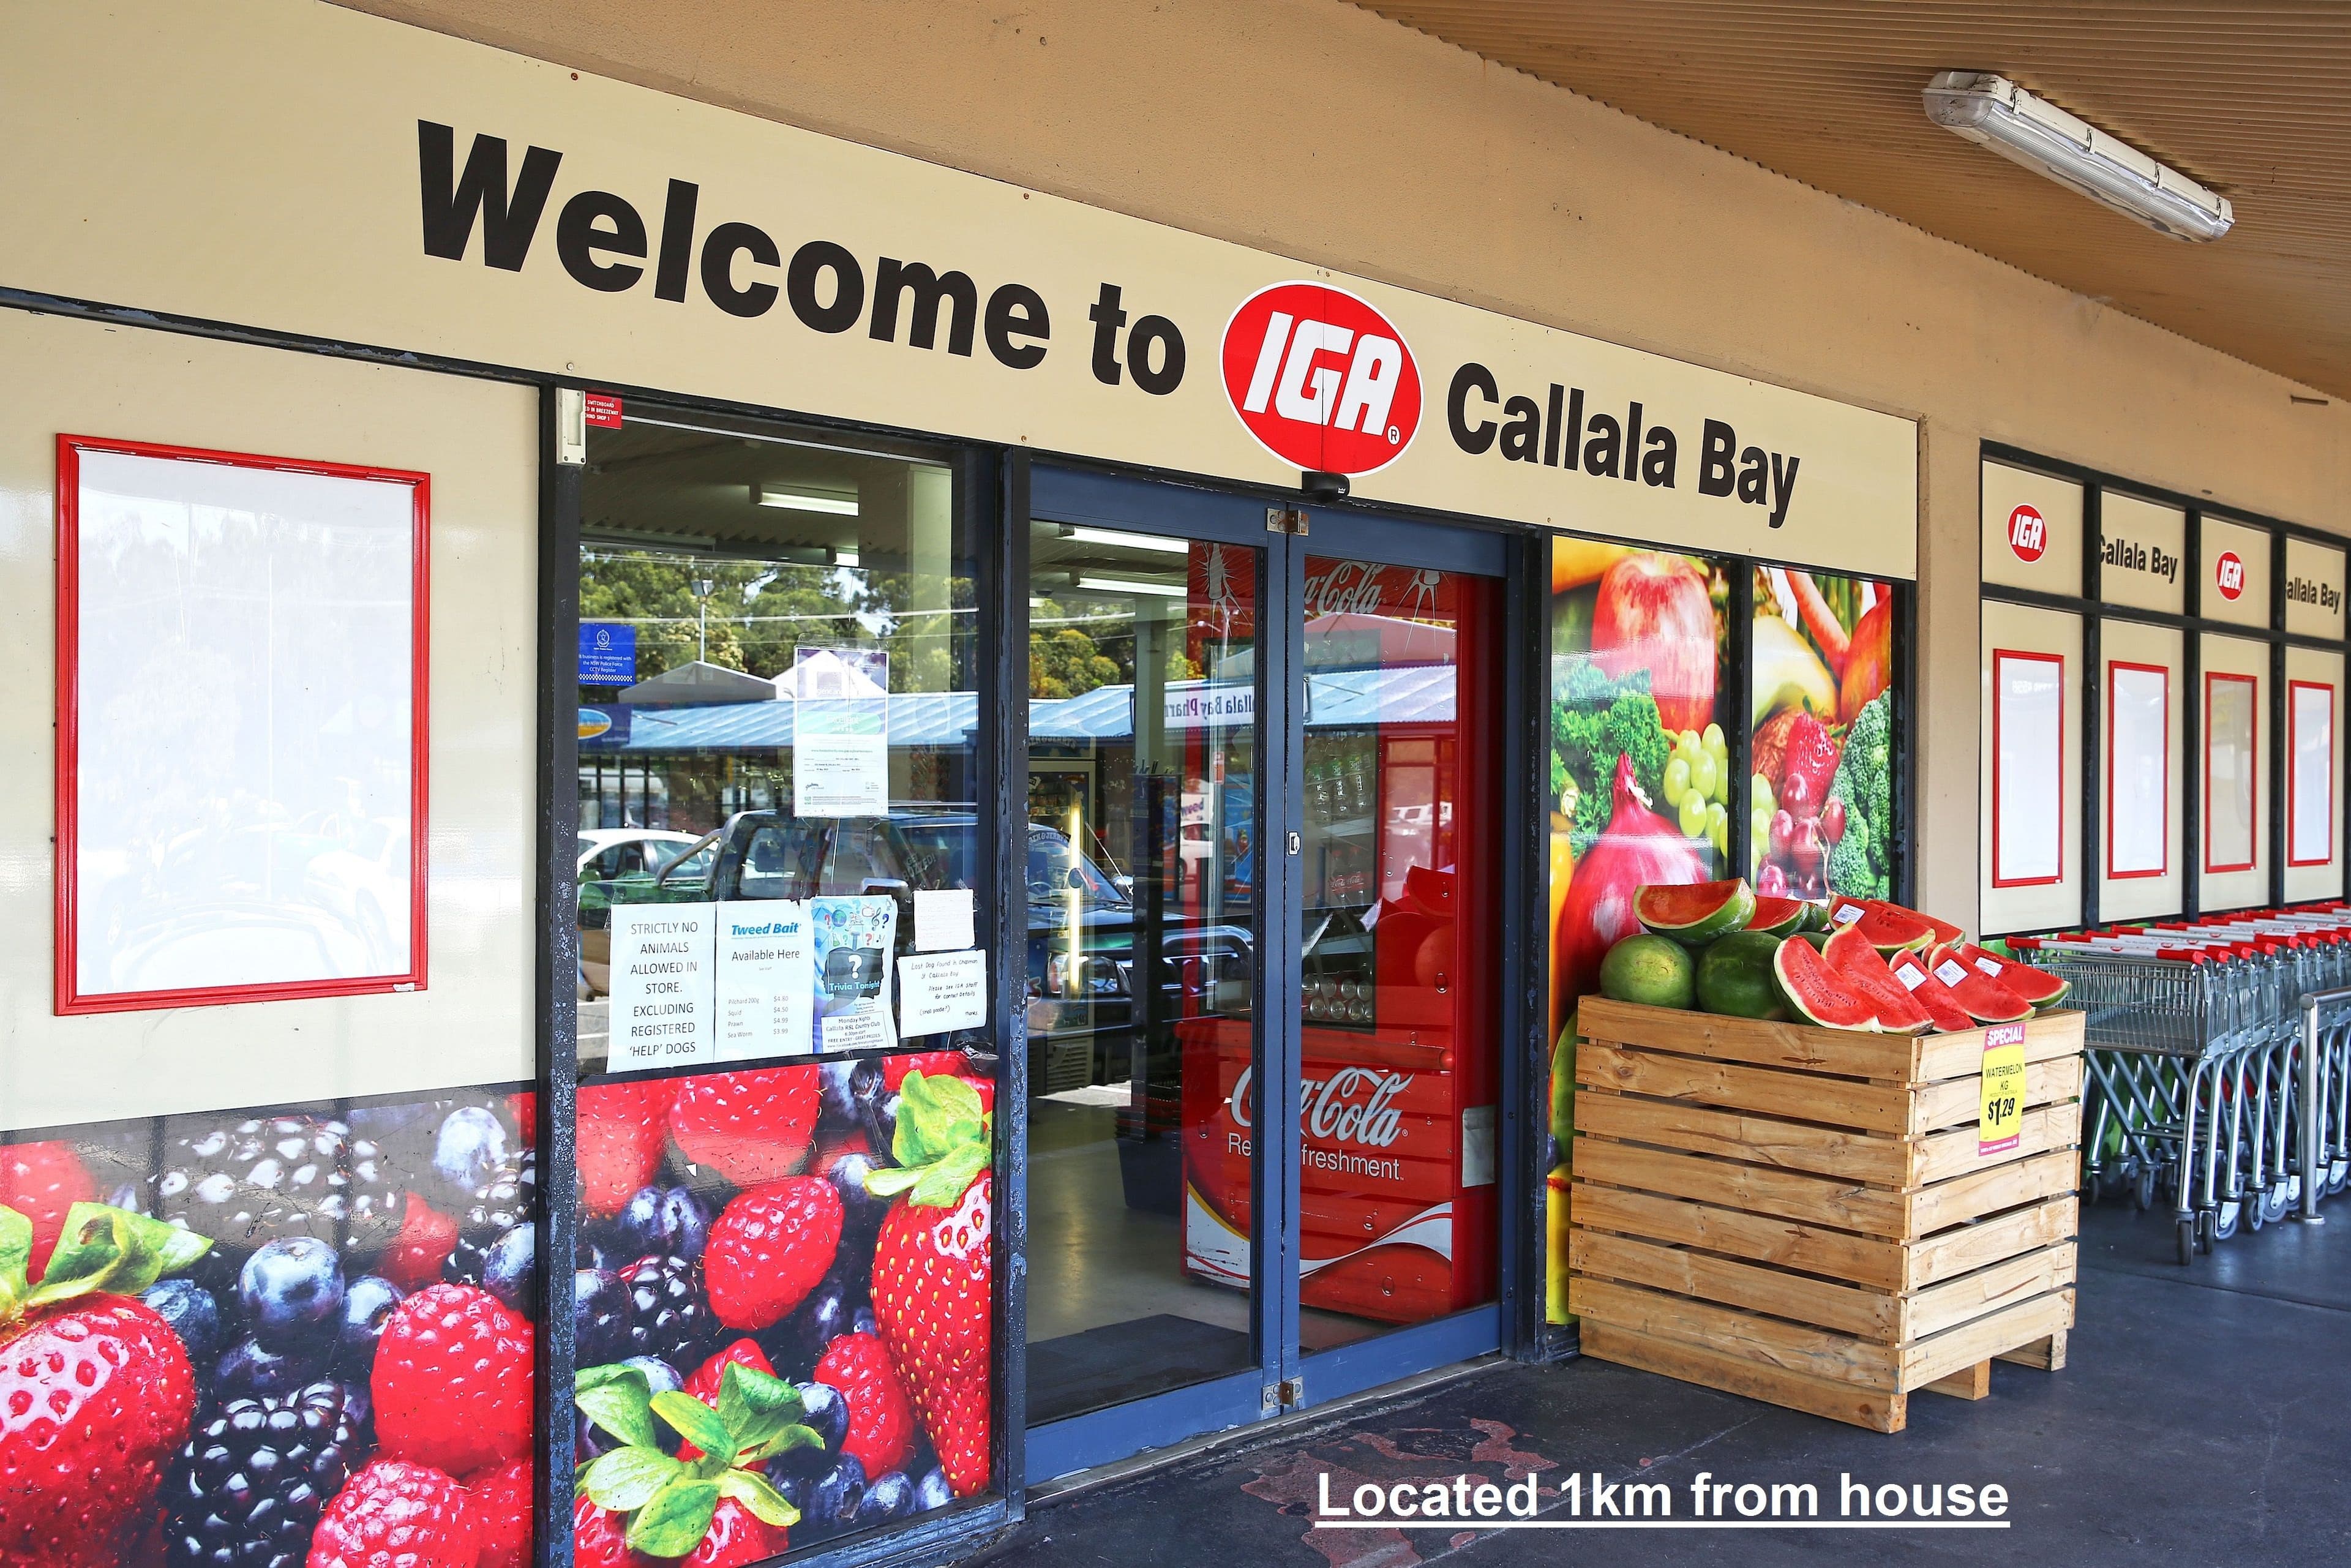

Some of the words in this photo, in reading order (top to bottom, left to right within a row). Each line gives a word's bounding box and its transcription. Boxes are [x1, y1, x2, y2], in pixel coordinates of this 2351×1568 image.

[418, 119, 1050, 370] Welcome
[1089, 282, 1186, 396] to
[1243, 310, 1403, 437] IGA
[1447, 362, 1678, 489] Callala
[1698, 418, 1801, 529] Bay
[587, 399, 615, 408] SWITCHBOARD
[2011, 513, 2043, 550] IGA
[2151, 546, 2178, 584] Bay
[2218, 560, 2242, 590] IGA
[1304, 561, 1387, 617] a-Cola
[2285, 577, 2317, 605] allala
[2320, 583, 2341, 615] Bay
[631, 922, 679, 935] STRICTLY
[682, 921, 698, 932] NO
[732, 923, 771, 935] Tweed
[773, 922, 799, 934] Bait
[640, 942, 689, 954] ANIMALS
[732, 949, 774, 961] Available
[778, 949, 800, 959] Here
[631, 962, 683, 975] ALLOWED
[686, 961, 697, 972] IN
[646, 982, 682, 994] STORE.
[854, 980, 880, 989] Tonight
[634, 1002, 694, 1016] EXCLUDING
[631, 1022, 695, 1037] REGISTERED
[1987, 1026, 2023, 1046] SPECIAL
[666, 1042, 696, 1054] DOGS
[1985, 1063, 2022, 1078] WATERMELON
[2000, 1080, 2009, 1090] KG
[1988, 1097, 2015, 1125] $1.29
[1302, 1144, 1400, 1180] freshment
